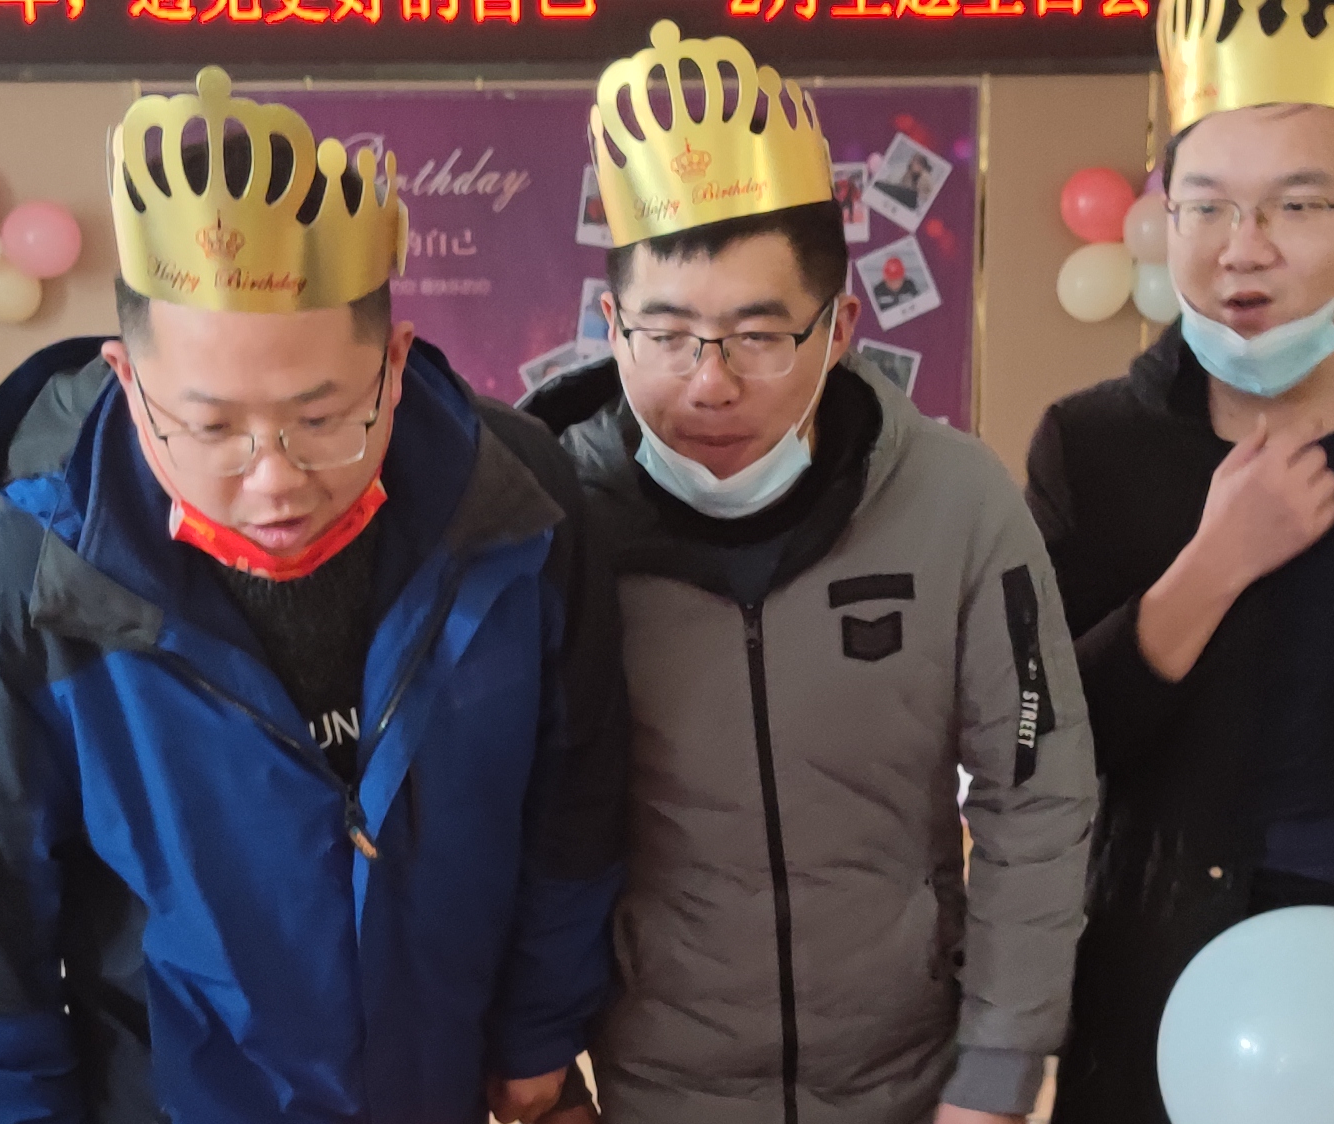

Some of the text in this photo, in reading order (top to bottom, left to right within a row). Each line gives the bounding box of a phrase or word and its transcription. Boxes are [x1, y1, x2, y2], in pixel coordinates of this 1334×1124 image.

[633, 177, 767, 222] Happy Birthday
[147, 253, 307, 297] Happy Birthday
[1018, 690, 1040, 749] STREET
